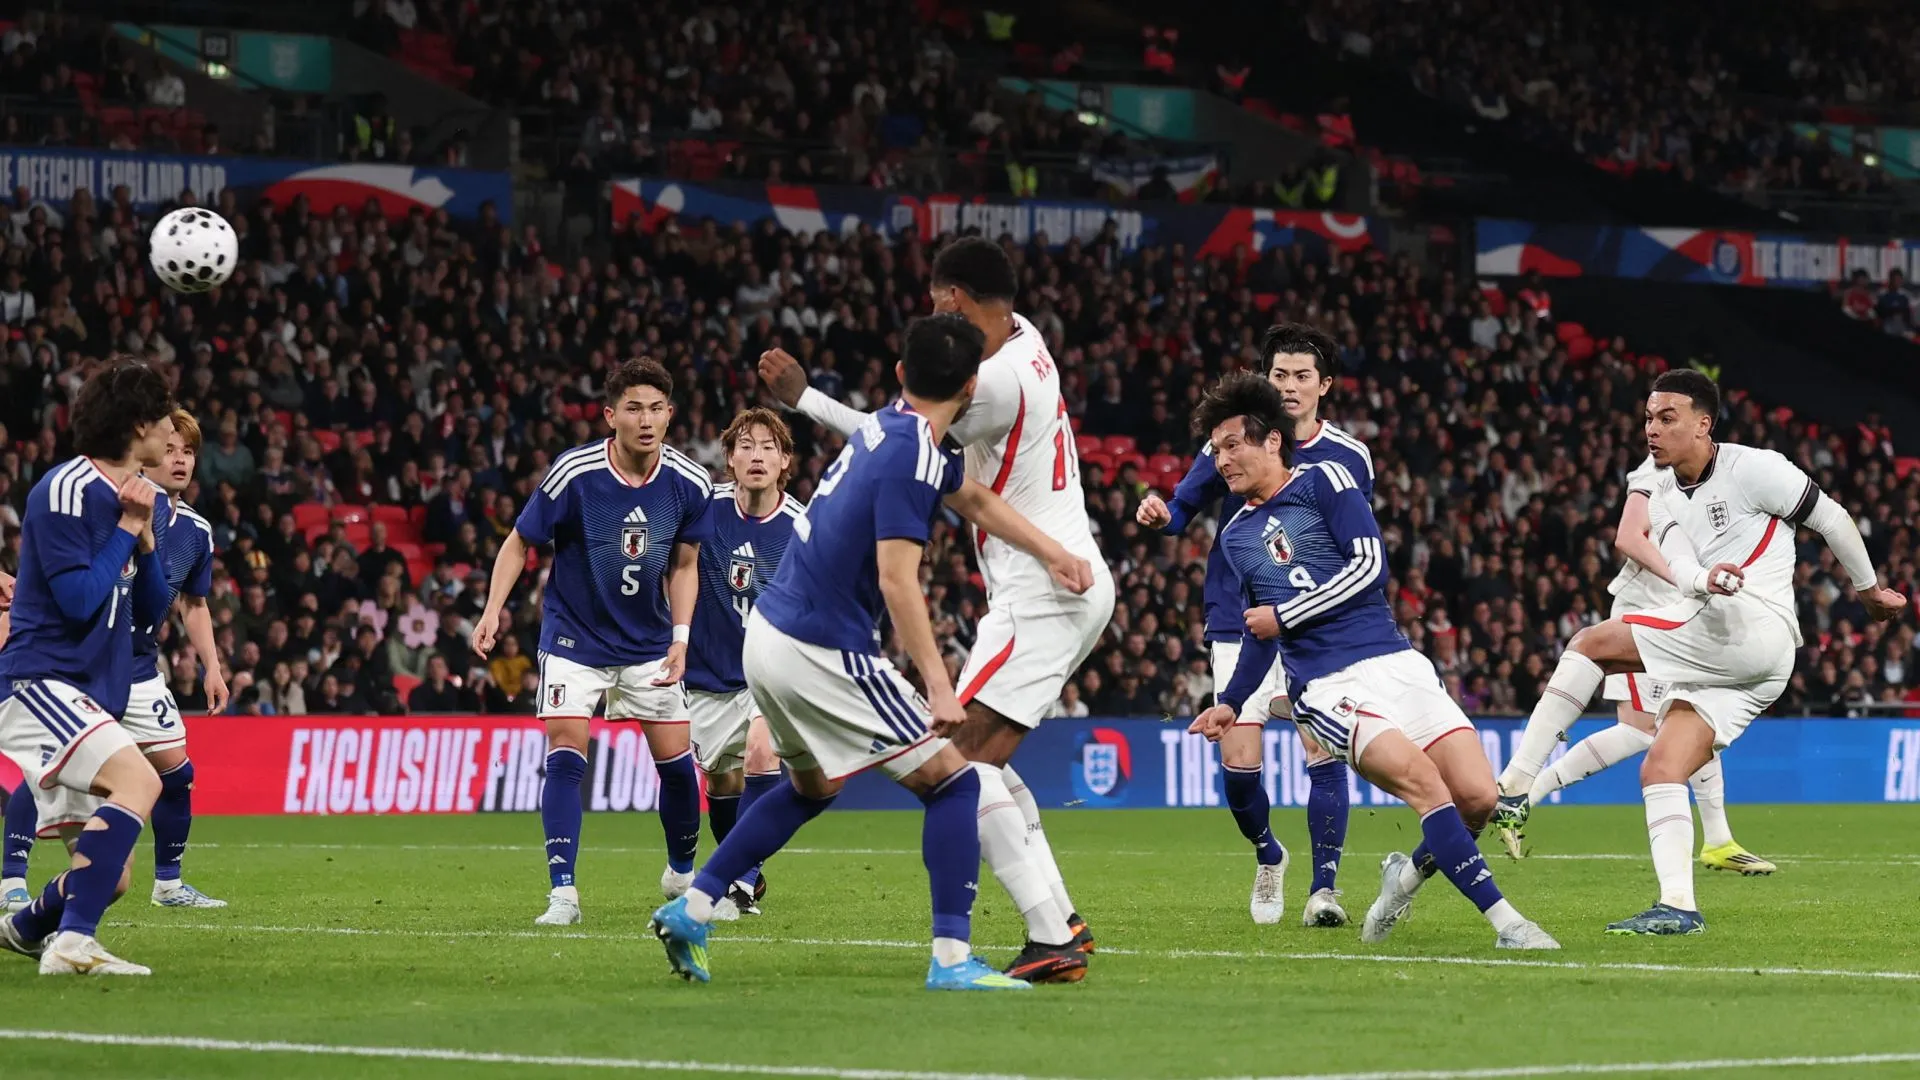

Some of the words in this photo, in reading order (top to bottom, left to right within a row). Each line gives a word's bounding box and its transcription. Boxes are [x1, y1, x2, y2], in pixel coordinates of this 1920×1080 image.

[17, 155, 96, 200] OFFICIAL
[102, 158, 184, 204] ENGLAND
[189, 163, 226, 207] APP
[621, 565, 642, 596] 5
[1288, 565, 1318, 595] 9
[732, 595, 750, 629] 4
[284, 727, 483, 815] EXCLUSIVE
[483, 728, 549, 812] FIR
[590, 728, 661, 812] LOO
[1160, 728, 1221, 807] THE
[8, 832, 35, 844] JAPA
[1455, 852, 1485, 874] JAPA
